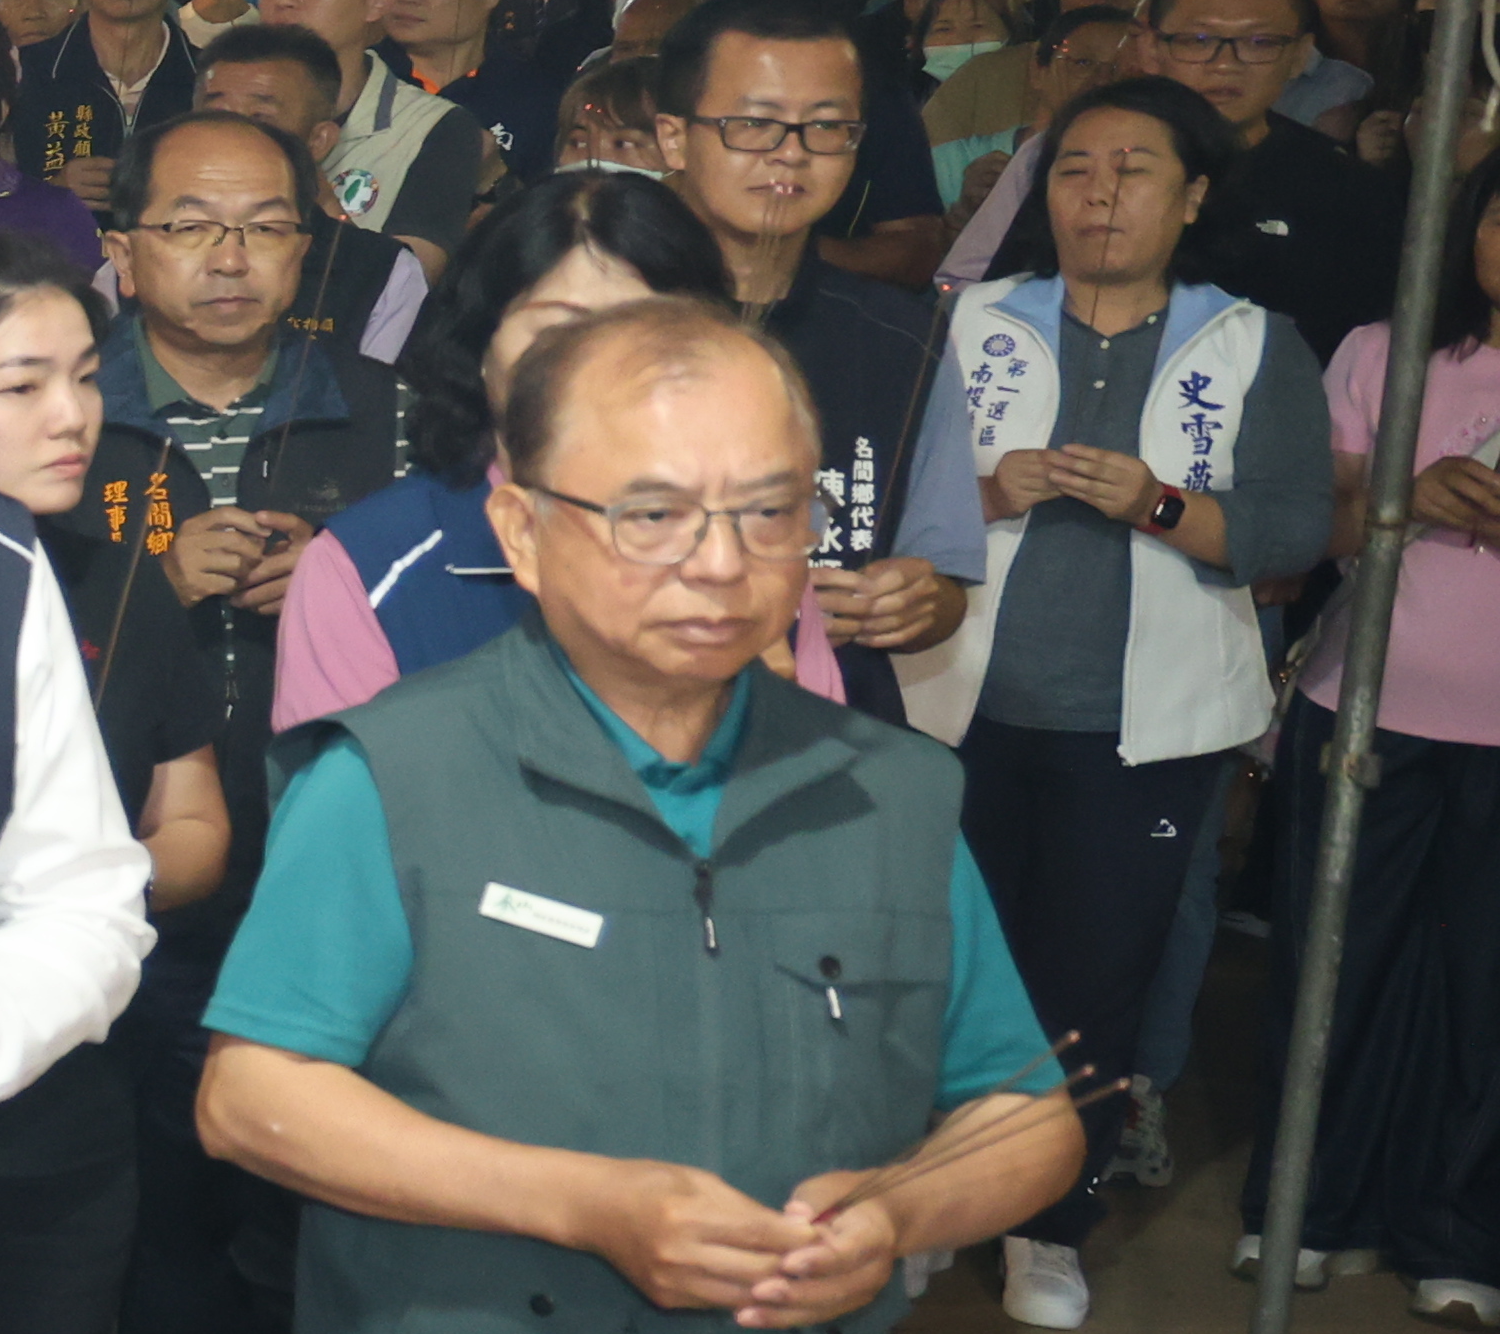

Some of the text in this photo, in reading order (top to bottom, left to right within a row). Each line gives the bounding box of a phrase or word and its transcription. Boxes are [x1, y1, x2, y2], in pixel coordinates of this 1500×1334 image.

[42, 110, 71, 181] 黃益
[979, 357, 1029, 447] 第一選區
[1178, 370, 1226, 492] 史雪燕
[142, 472, 175, 555] 名間鄉
[850, 435, 875, 551] 名間鄉代表
